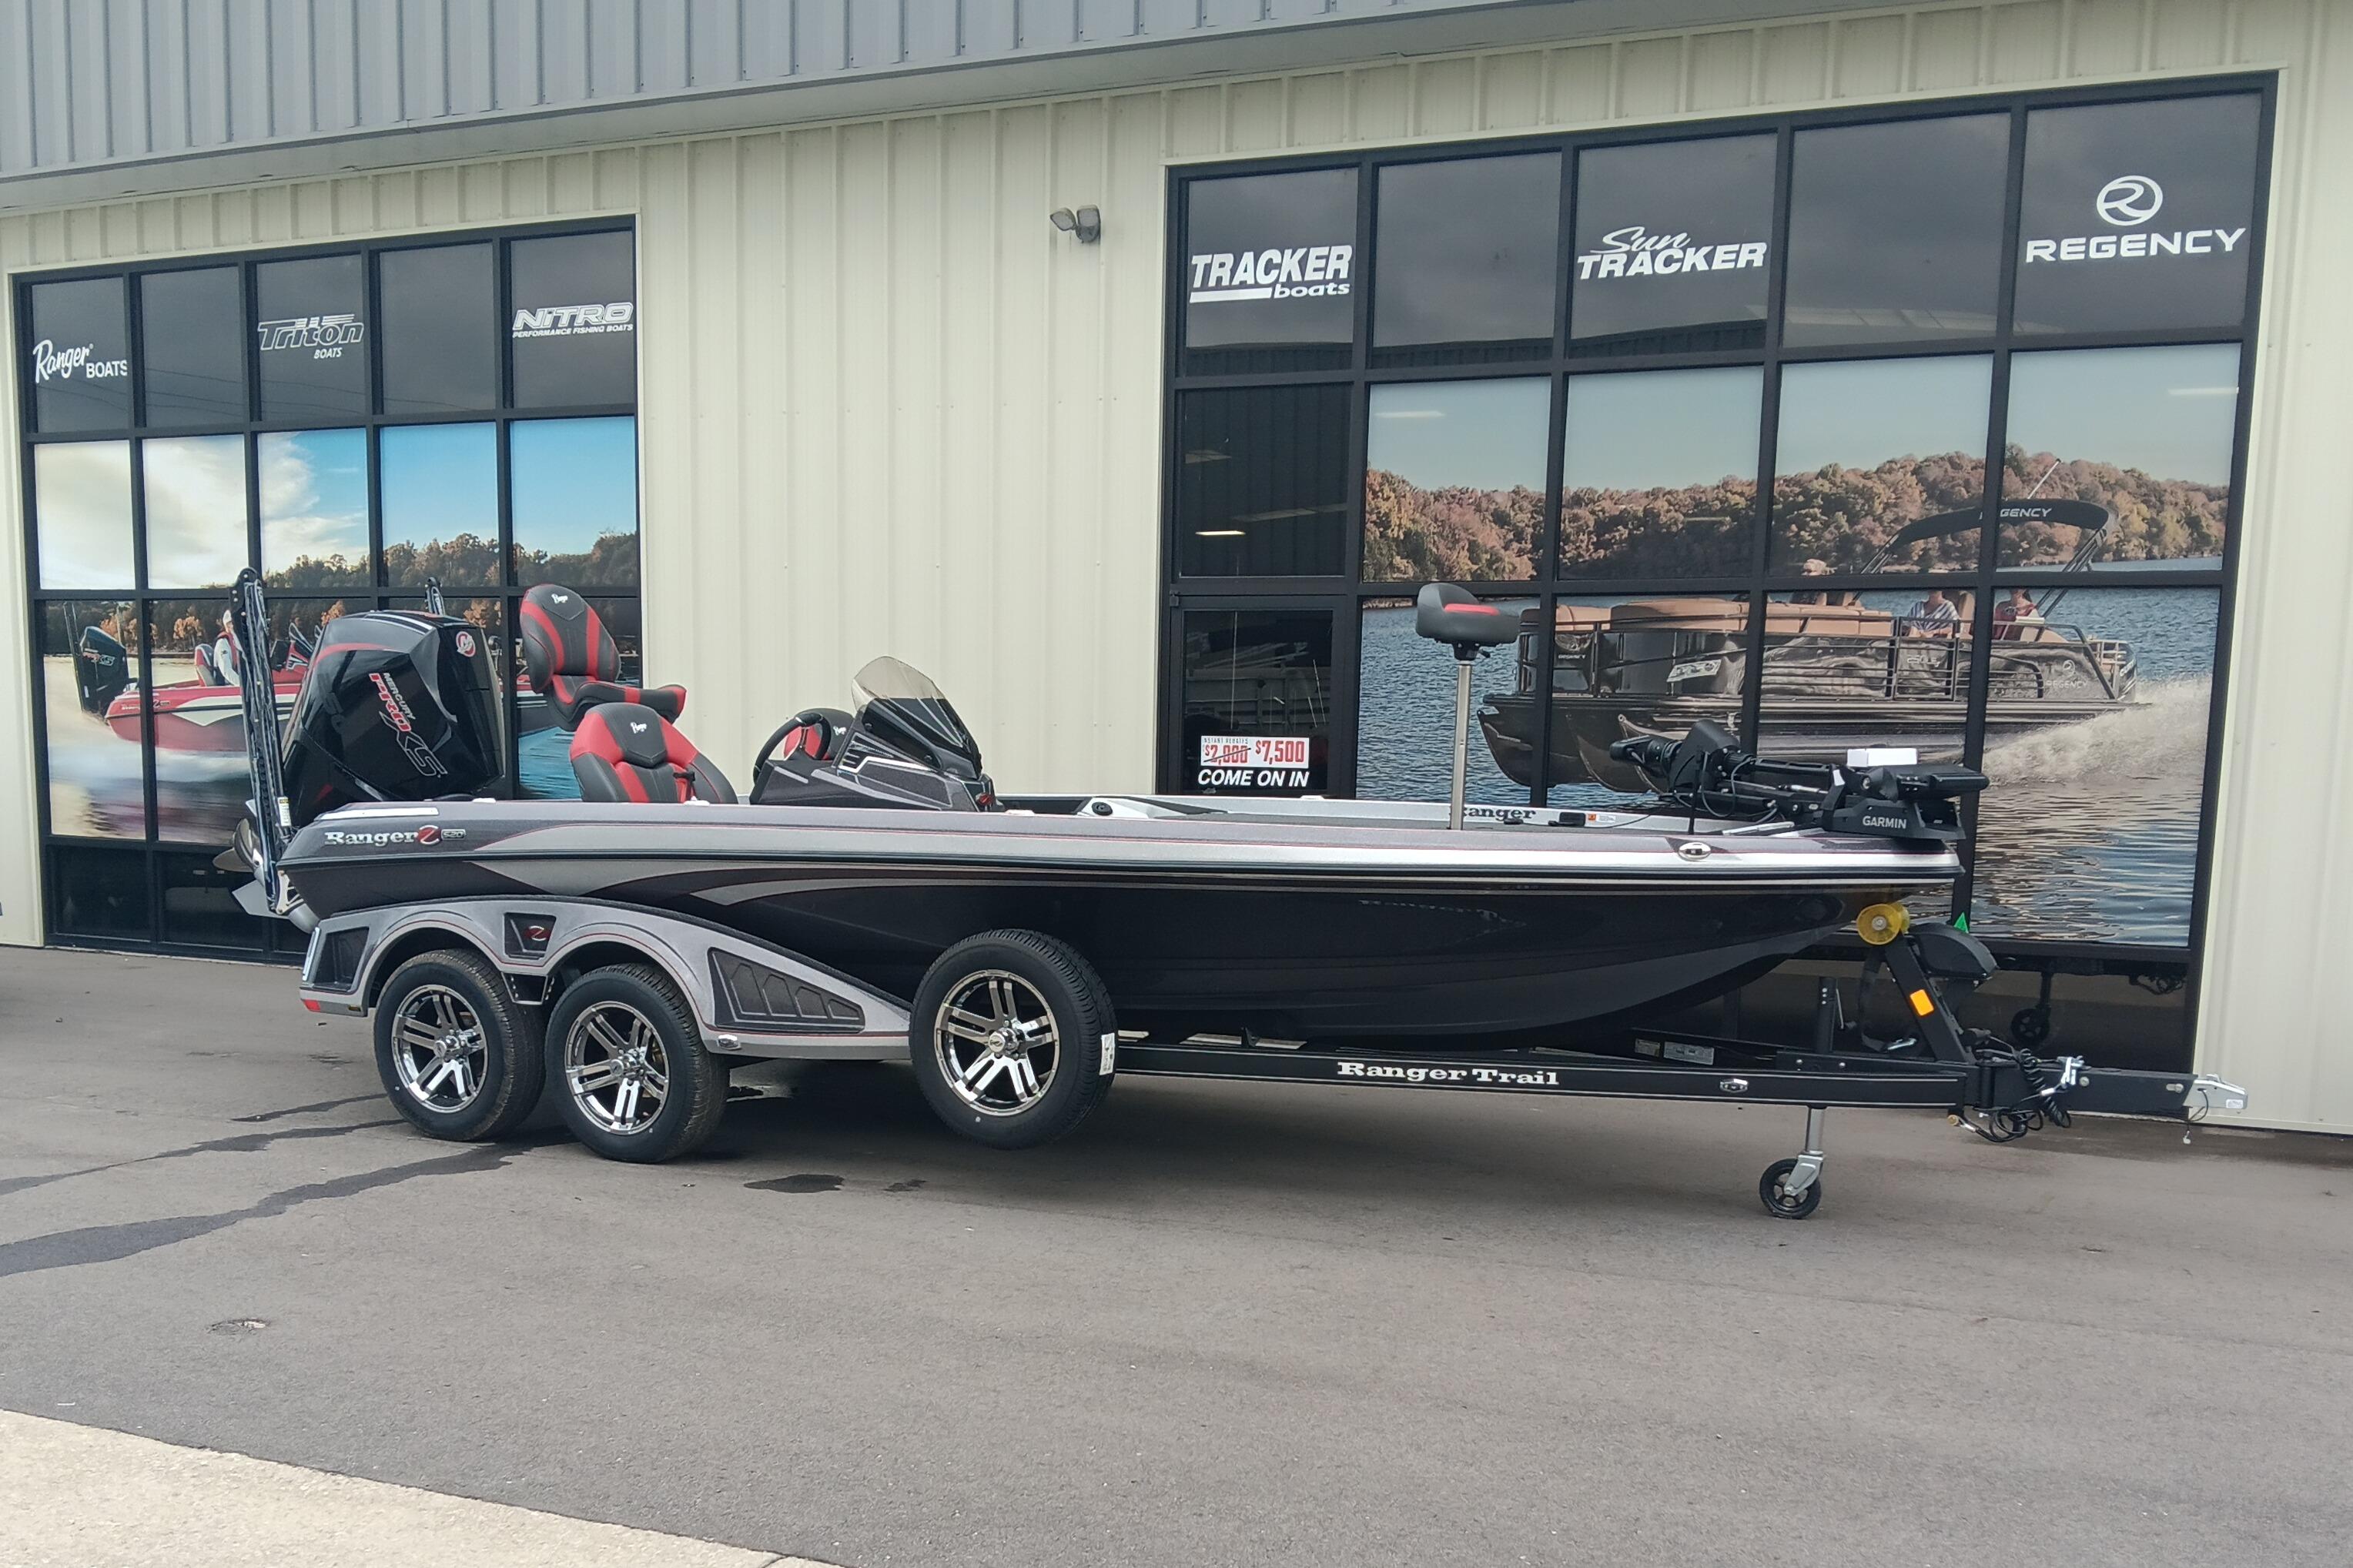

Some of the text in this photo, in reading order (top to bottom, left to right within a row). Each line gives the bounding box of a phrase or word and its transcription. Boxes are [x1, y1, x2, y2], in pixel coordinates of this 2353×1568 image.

[1590, 226, 1691, 253] Sun
[2026, 228, 2246, 262] REGENCY
[1191, 245, 1353, 288] TRACKER
[1577, 242, 1767, 279] TRACKER
[1274, 283, 1351, 299] boats
[257, 314, 364, 350] Triton
[512, 323, 633, 338] PERFORMANCE FISHING BOATS
[32, 339, 128, 383] Ranger BOATS
[313, 347, 343, 359] BOATS
[383, 672, 416, 720] MERCURY
[1255, 740, 1304, 764] $7,500
[1198, 769, 1309, 787] COME ON IN
[1455, 807, 1536, 821] anger
[1863, 816, 1906, 829] GARMIN
[324, 831, 420, 847] Ranger
[1337, 1061, 1559, 1085] Ranger Trail
